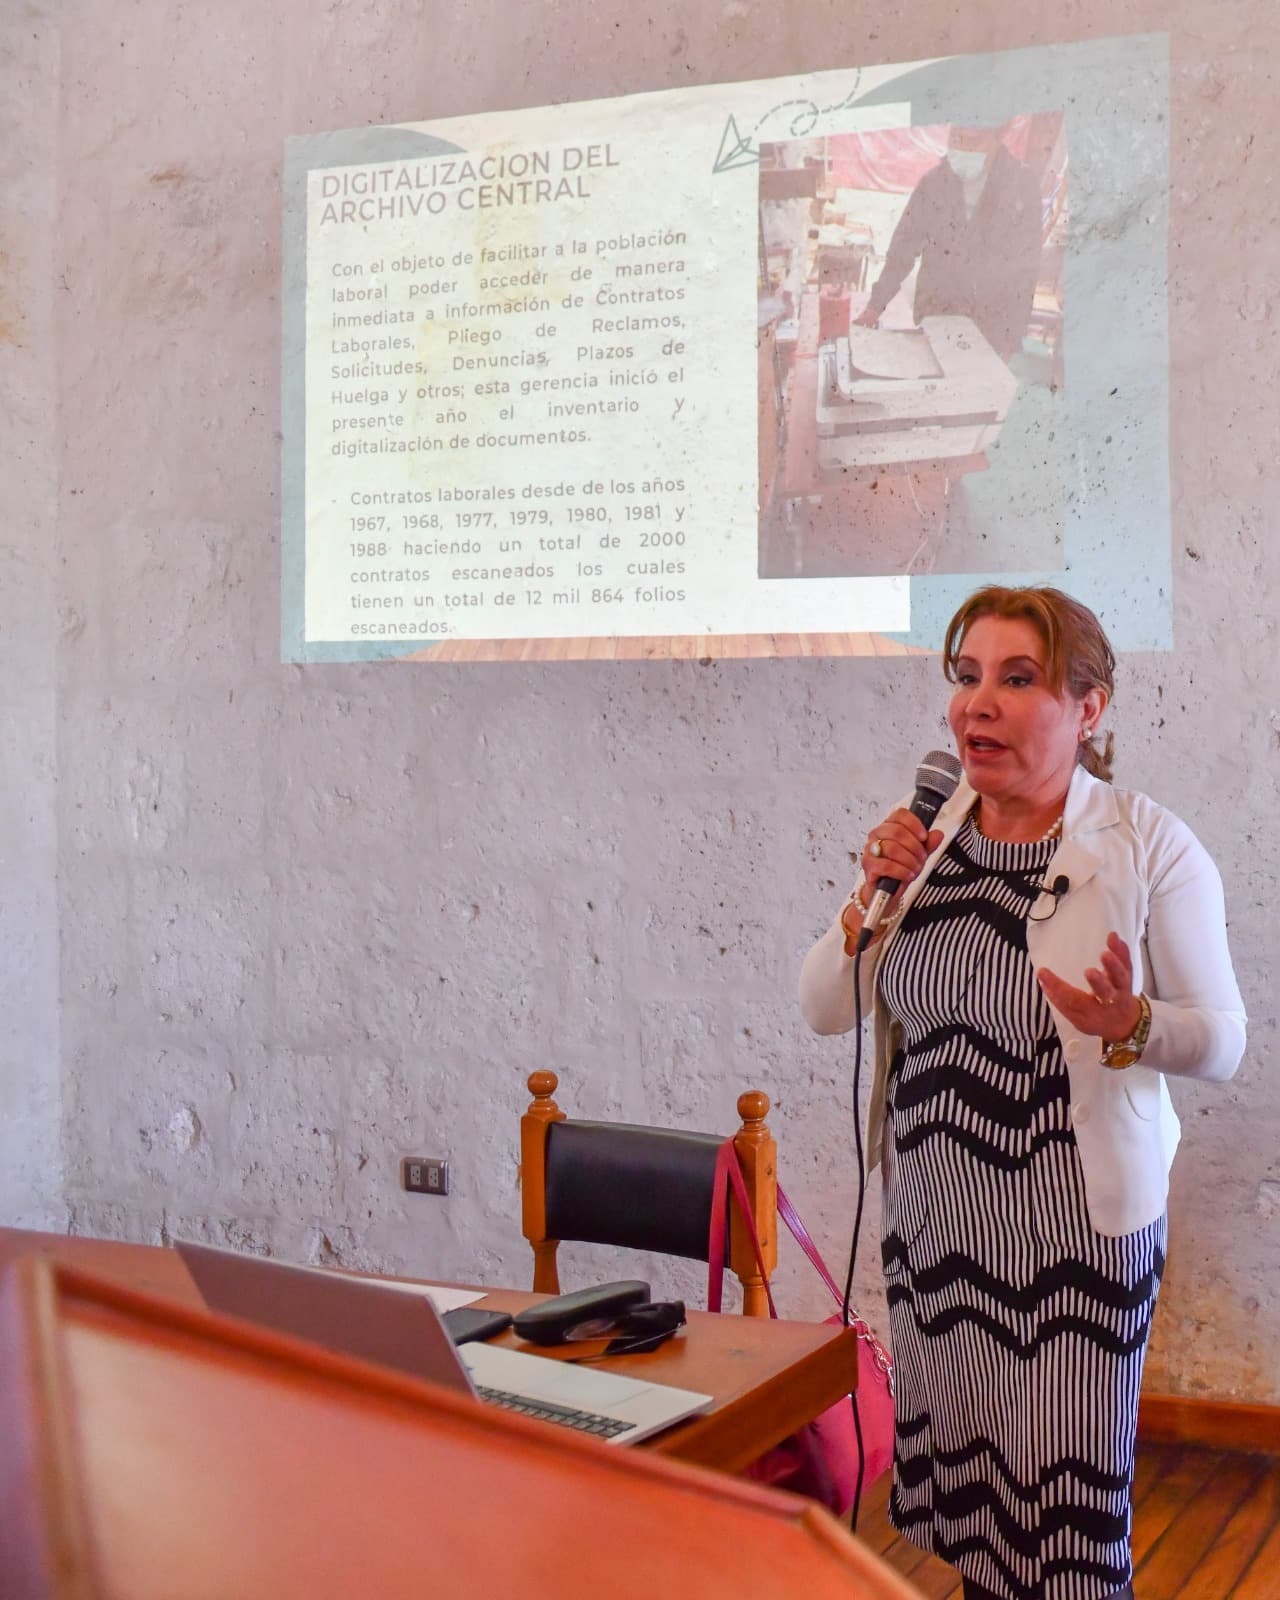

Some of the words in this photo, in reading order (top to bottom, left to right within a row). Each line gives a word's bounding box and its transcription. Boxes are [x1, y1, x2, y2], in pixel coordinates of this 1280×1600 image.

[321, 151, 551, 199] DIGITALIZACION
[563, 143, 620, 171] DEL
[320, 191, 446, 226] ARCHIVO
[457, 175, 591, 209] CENTRAL
[332, 263, 363, 278] Con
[370, 259, 384, 274] el
[391, 255, 445, 274] objeto
[452, 250, 473, 267] de
[480, 245, 547, 263] facilitar
[555, 244, 564, 257] a
[572, 239, 587, 255] la
[595, 230, 687, 254] población
[332, 285, 388, 303] laboral
[409, 279, 458, 298] poder
[479, 271, 548, 290] acceder
[570, 266, 592, 282] de
[615, 259, 685, 278] manera
[332, 310, 414, 329] inmediata
[425, 309, 434, 321] a
[445, 298, 550, 318] información
[561, 294, 584, 309] de
[595, 287, 685, 305] Contratos
[332, 336, 415, 354] Laborales,
[448, 328, 502, 347] Pliego
[535, 323, 557, 338] de
[592, 314, 686, 333] Reclamos,
[331, 361, 428, 380] Solicitudes,
[452, 352, 550, 371] Denuncias,
[577, 345, 634, 362] Plazos
[662, 340, 685, 356] de
[331, 389, 389, 405] Huelga
[398, 389, 407, 404] y
[416, 382, 466, 400] otros;
[474, 378, 510, 395] esta
[520, 371, 598, 395] gerencia
[609, 367, 658, 387] inició
[668, 366, 684, 383] el
[332, 413, 404, 433] presente
[436, 409, 467, 424] año
[499, 406, 514, 421] el
[547, 399, 640, 418] inventario
[674, 396, 685, 416] y
[331, 435, 444, 458] digitalización
[449, 434, 470, 450] de
[476, 429, 592, 448] documentos.
[350, 490, 432, 506] Contratos
[437, 484, 516, 502] laborales
[521, 482, 576, 499] desde
[582, 480, 605, 496] de
[610, 479, 635, 495] los
[641, 475, 685, 493] años
[350, 517, 392, 533] 1967,
[402, 514, 443, 530] 1968,
[456, 512, 498, 530] 1977,
[510, 509, 553, 527] 1979,
[567, 507, 612, 524] 1980,
[625, 504, 662, 521] 1981
[675, 507, 685, 523] y
[350, 542, 387, 558] 1988
[403, 537, 481, 556] haciendo
[499, 538, 522, 553] un
[539, 534, 581, 552] total
[599, 532, 621, 549] de
[639, 530, 686, 548] 2000
[350, 566, 431, 583] contratos
[451, 562, 554, 580] escaneados
[577, 561, 603, 577] los
[626, 558, 686, 576] cuales
[350, 593, 404, 609] tienen
[413, 593, 434, 607] un
[444, 590, 484, 607] total
[493, 589, 515, 606] de
[526, 589, 543, 605] 12
[553, 587, 580, 605] mil
[591, 587, 624, 605] 864
[634, 585, 686, 602] folios
[350, 618, 453, 635] escaneados.
